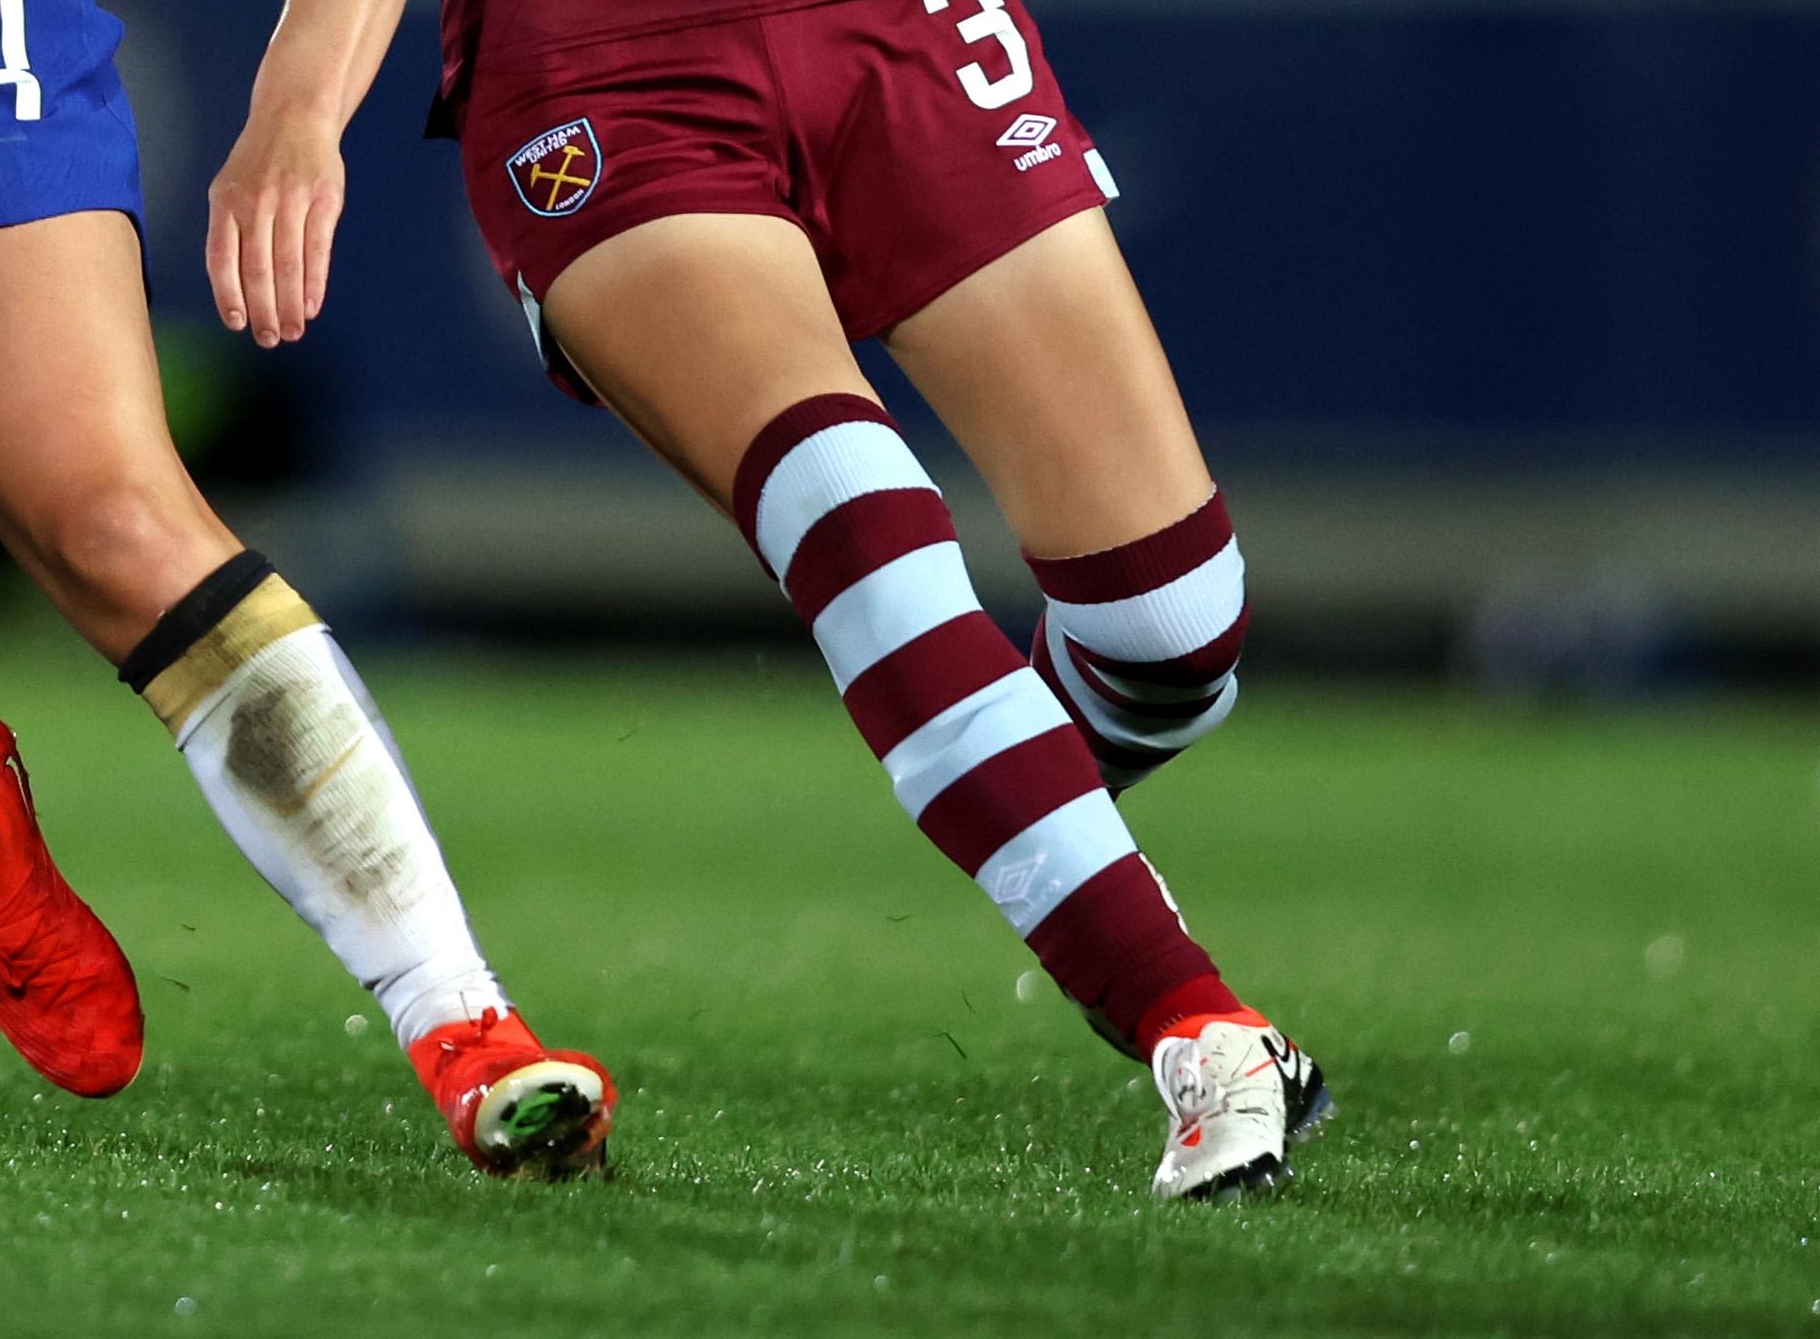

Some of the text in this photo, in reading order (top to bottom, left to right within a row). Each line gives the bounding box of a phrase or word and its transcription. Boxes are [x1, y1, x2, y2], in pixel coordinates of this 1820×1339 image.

[515, 126, 581, 167] WEST HAM
[1013, 143, 1062, 171] umbro
[555, 188, 584, 209] LONDON
